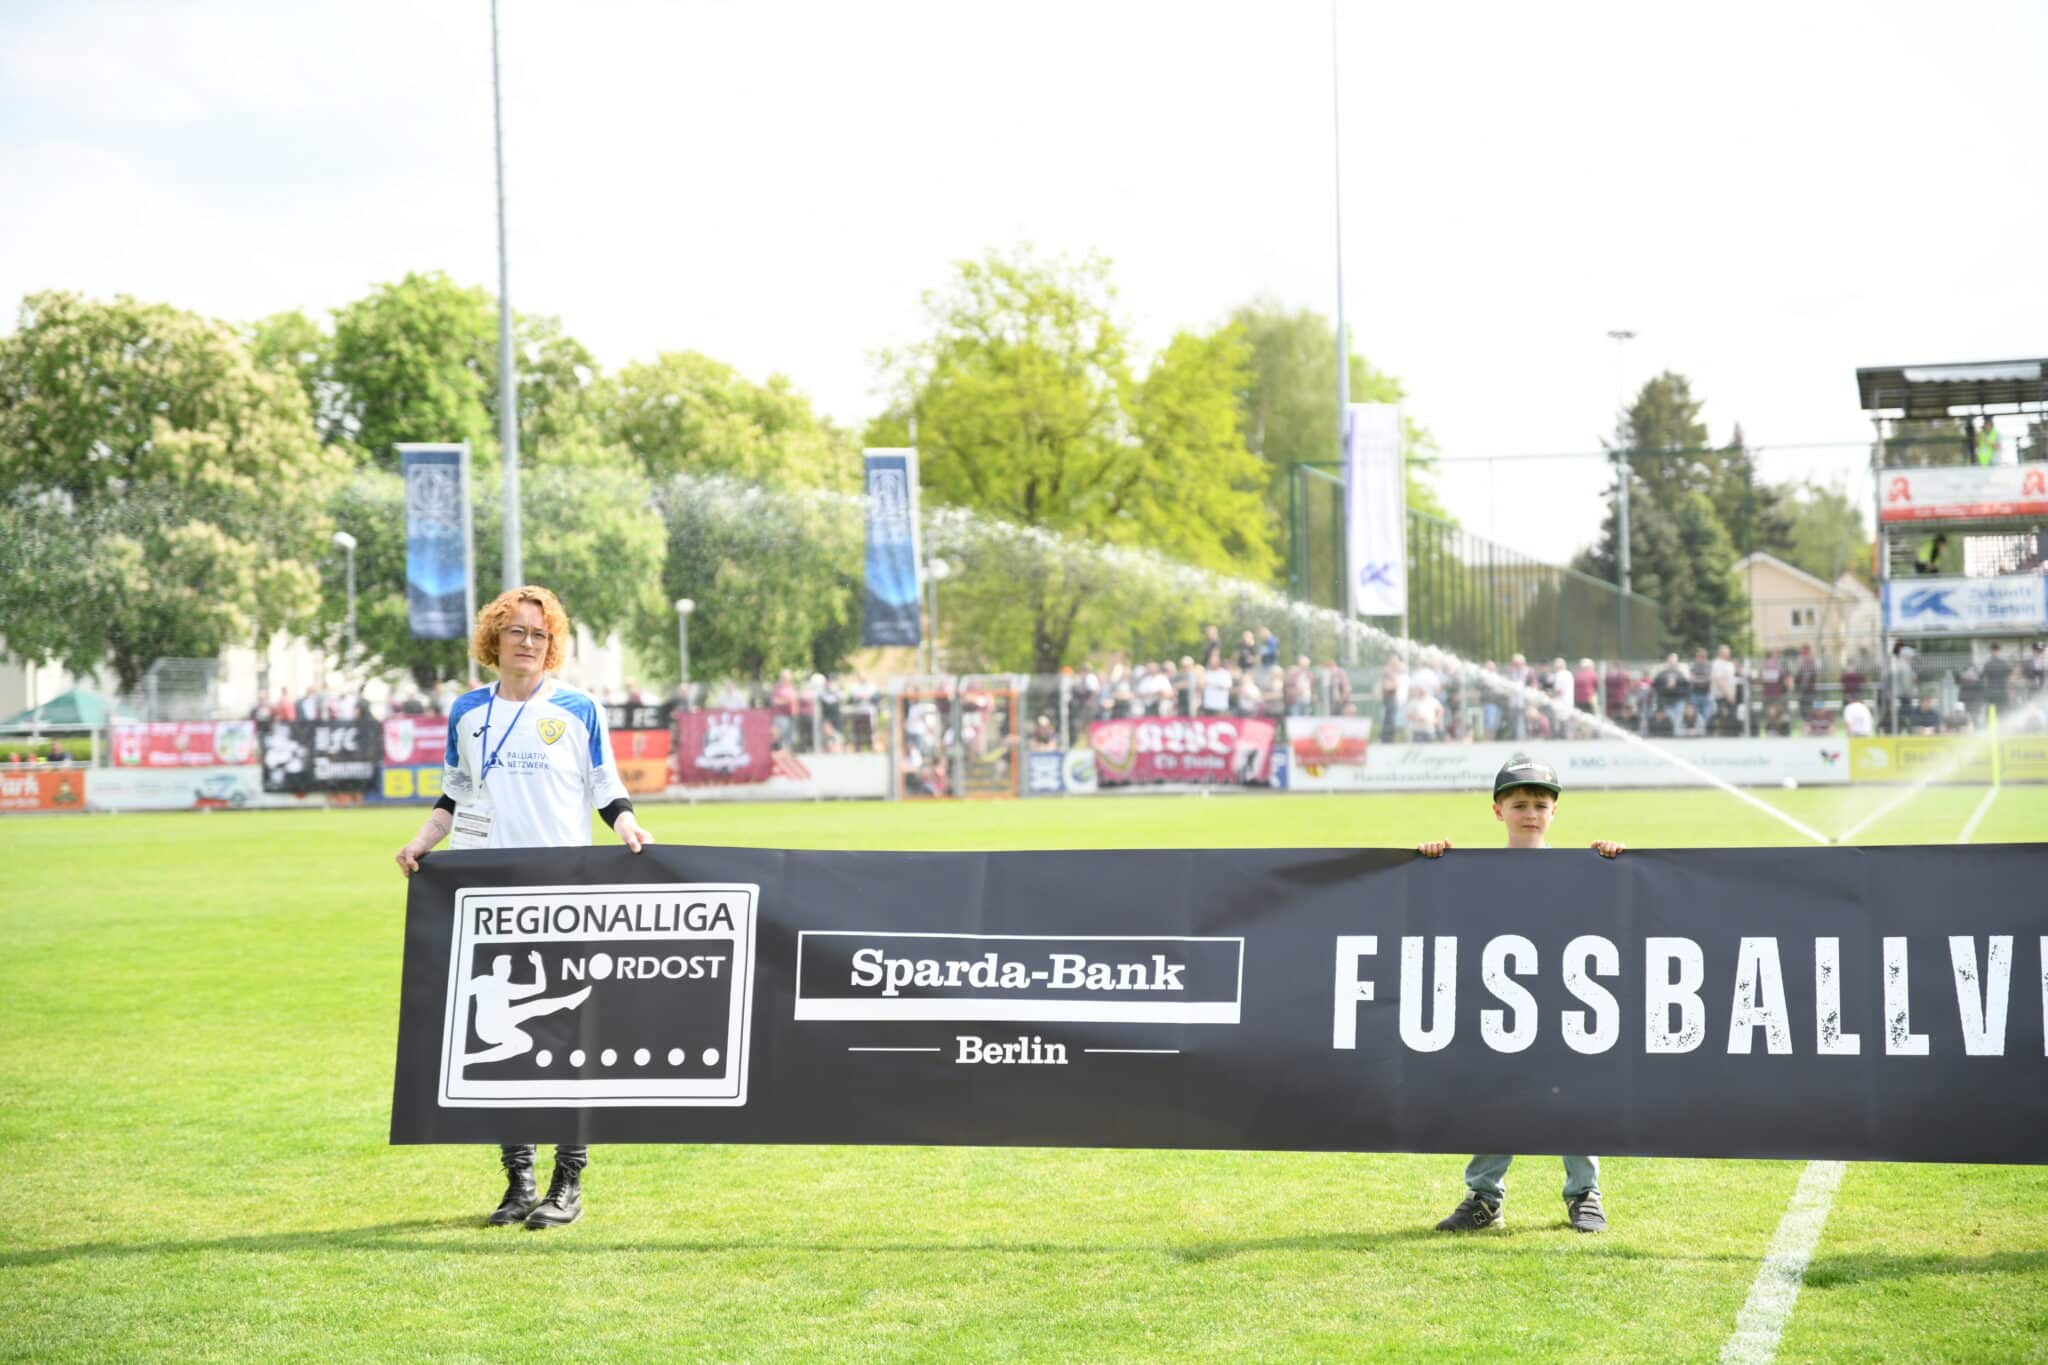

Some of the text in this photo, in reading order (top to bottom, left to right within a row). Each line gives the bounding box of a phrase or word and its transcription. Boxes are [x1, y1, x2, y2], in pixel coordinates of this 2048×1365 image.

[474, 902, 736, 936] REGIONALLIGA
[561, 953, 727, 981] NORDOST
[850, 948, 1186, 997] Sparda-Bank
[955, 1036, 1068, 1065] Berlin
